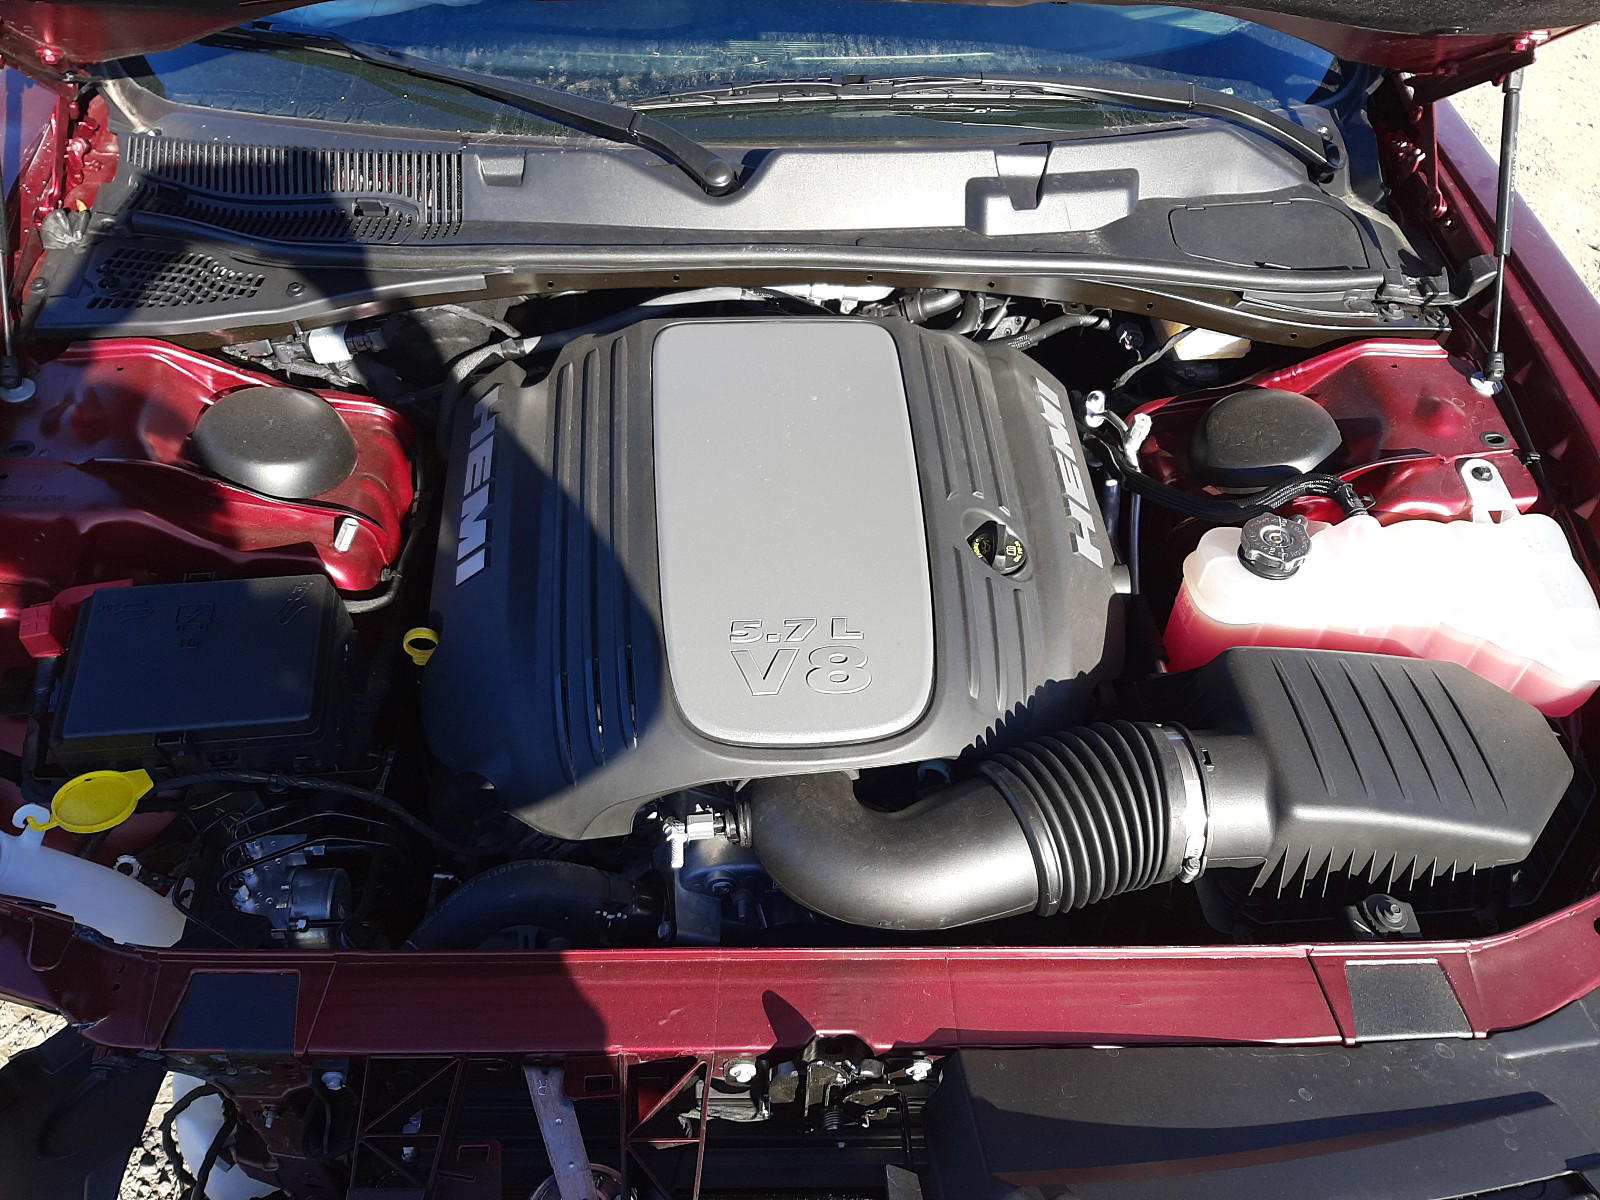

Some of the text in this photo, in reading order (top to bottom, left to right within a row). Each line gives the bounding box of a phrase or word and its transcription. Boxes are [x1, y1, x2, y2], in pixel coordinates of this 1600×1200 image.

[456, 384, 501, 587] HEMI
[1036, 376, 1104, 569] HEMI
[730, 645, 873, 696] V8
